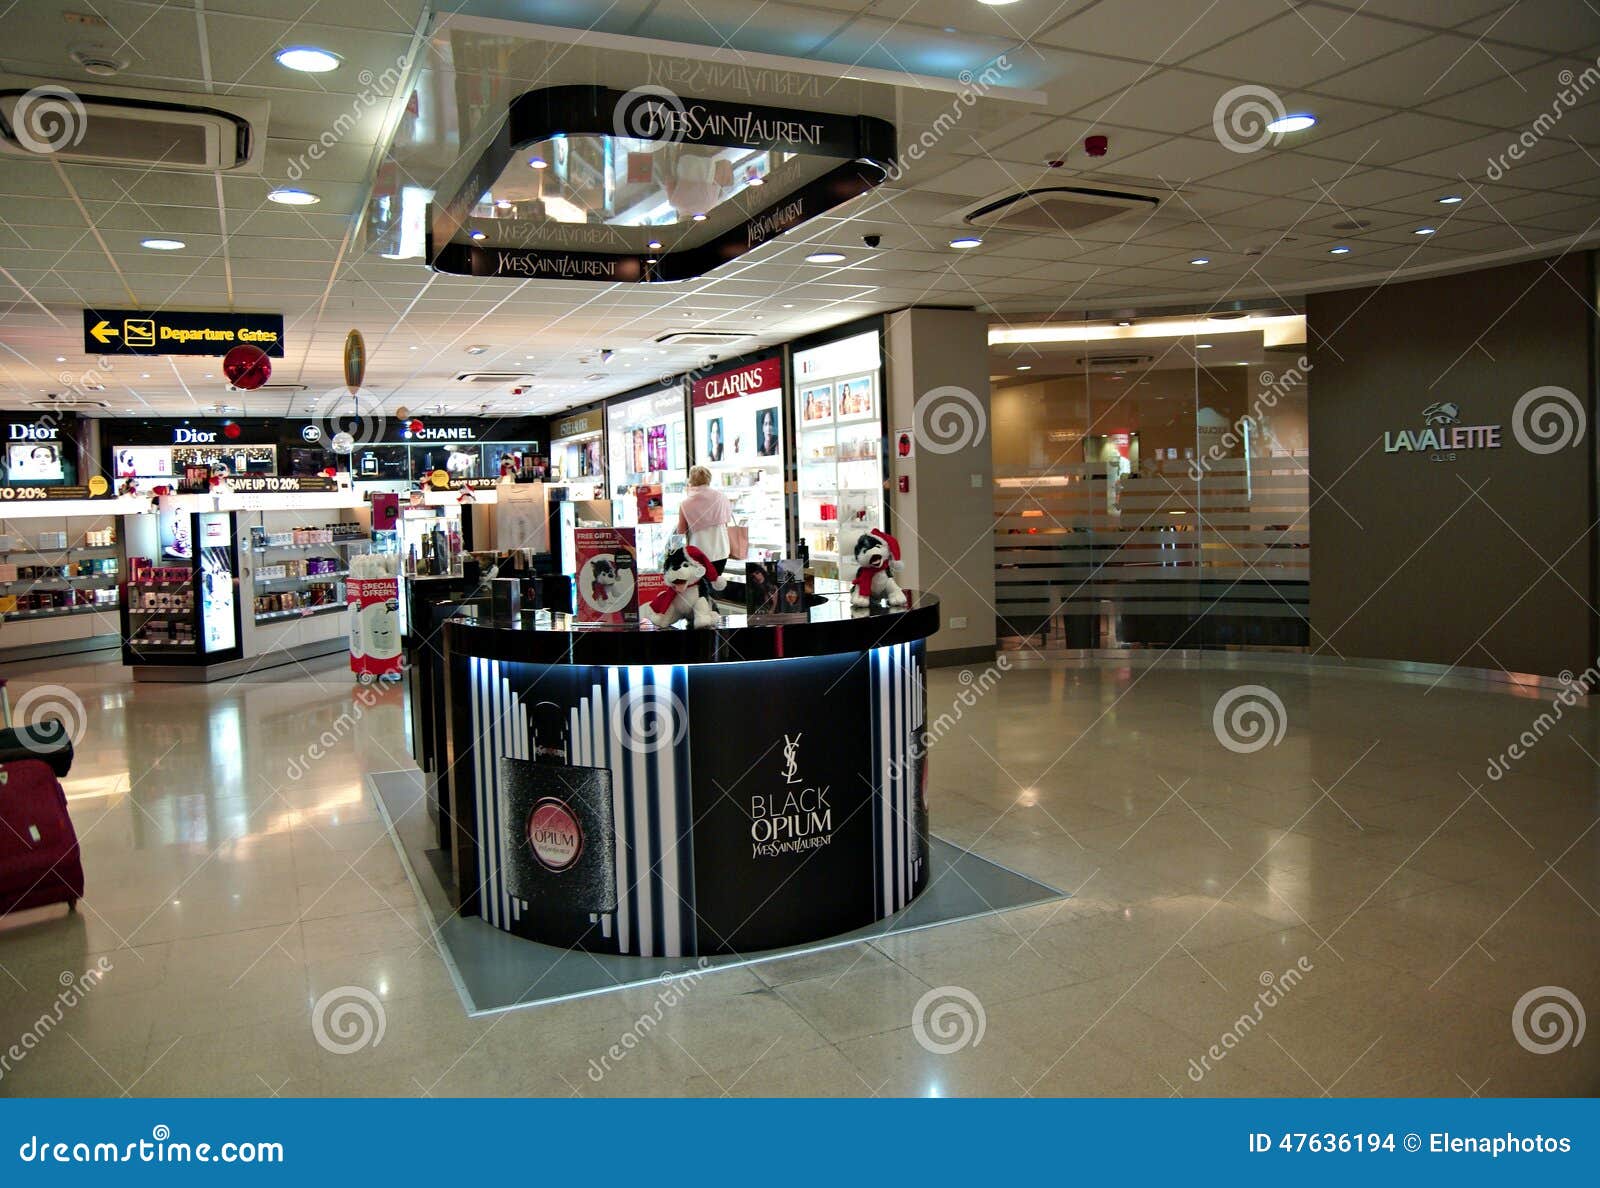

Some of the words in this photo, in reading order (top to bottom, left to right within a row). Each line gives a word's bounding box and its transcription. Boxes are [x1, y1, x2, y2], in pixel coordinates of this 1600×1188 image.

[160, 327, 234, 343] Departure
[238, 328, 277, 342] Gates
[705, 368, 762, 399] CLARINS
[9, 424, 59, 439] Dior
[174, 428, 217, 443] Dior
[416, 427, 476, 439] CHANEL
[1384, 425, 1501, 453] LAVALETTE
[230, 478, 251, 490] SAVE
[252, 478, 265, 490] UP
[265, 478, 279, 490] TO
[280, 478, 299, 490] 20%
[16, 487, 47, 499] 20%
[362, 582, 397, 590] SPECIAL
[751, 785, 831, 819] BLACK
[751, 809, 832, 842] OPIUM
[534, 829, 574, 847] OPIUM
